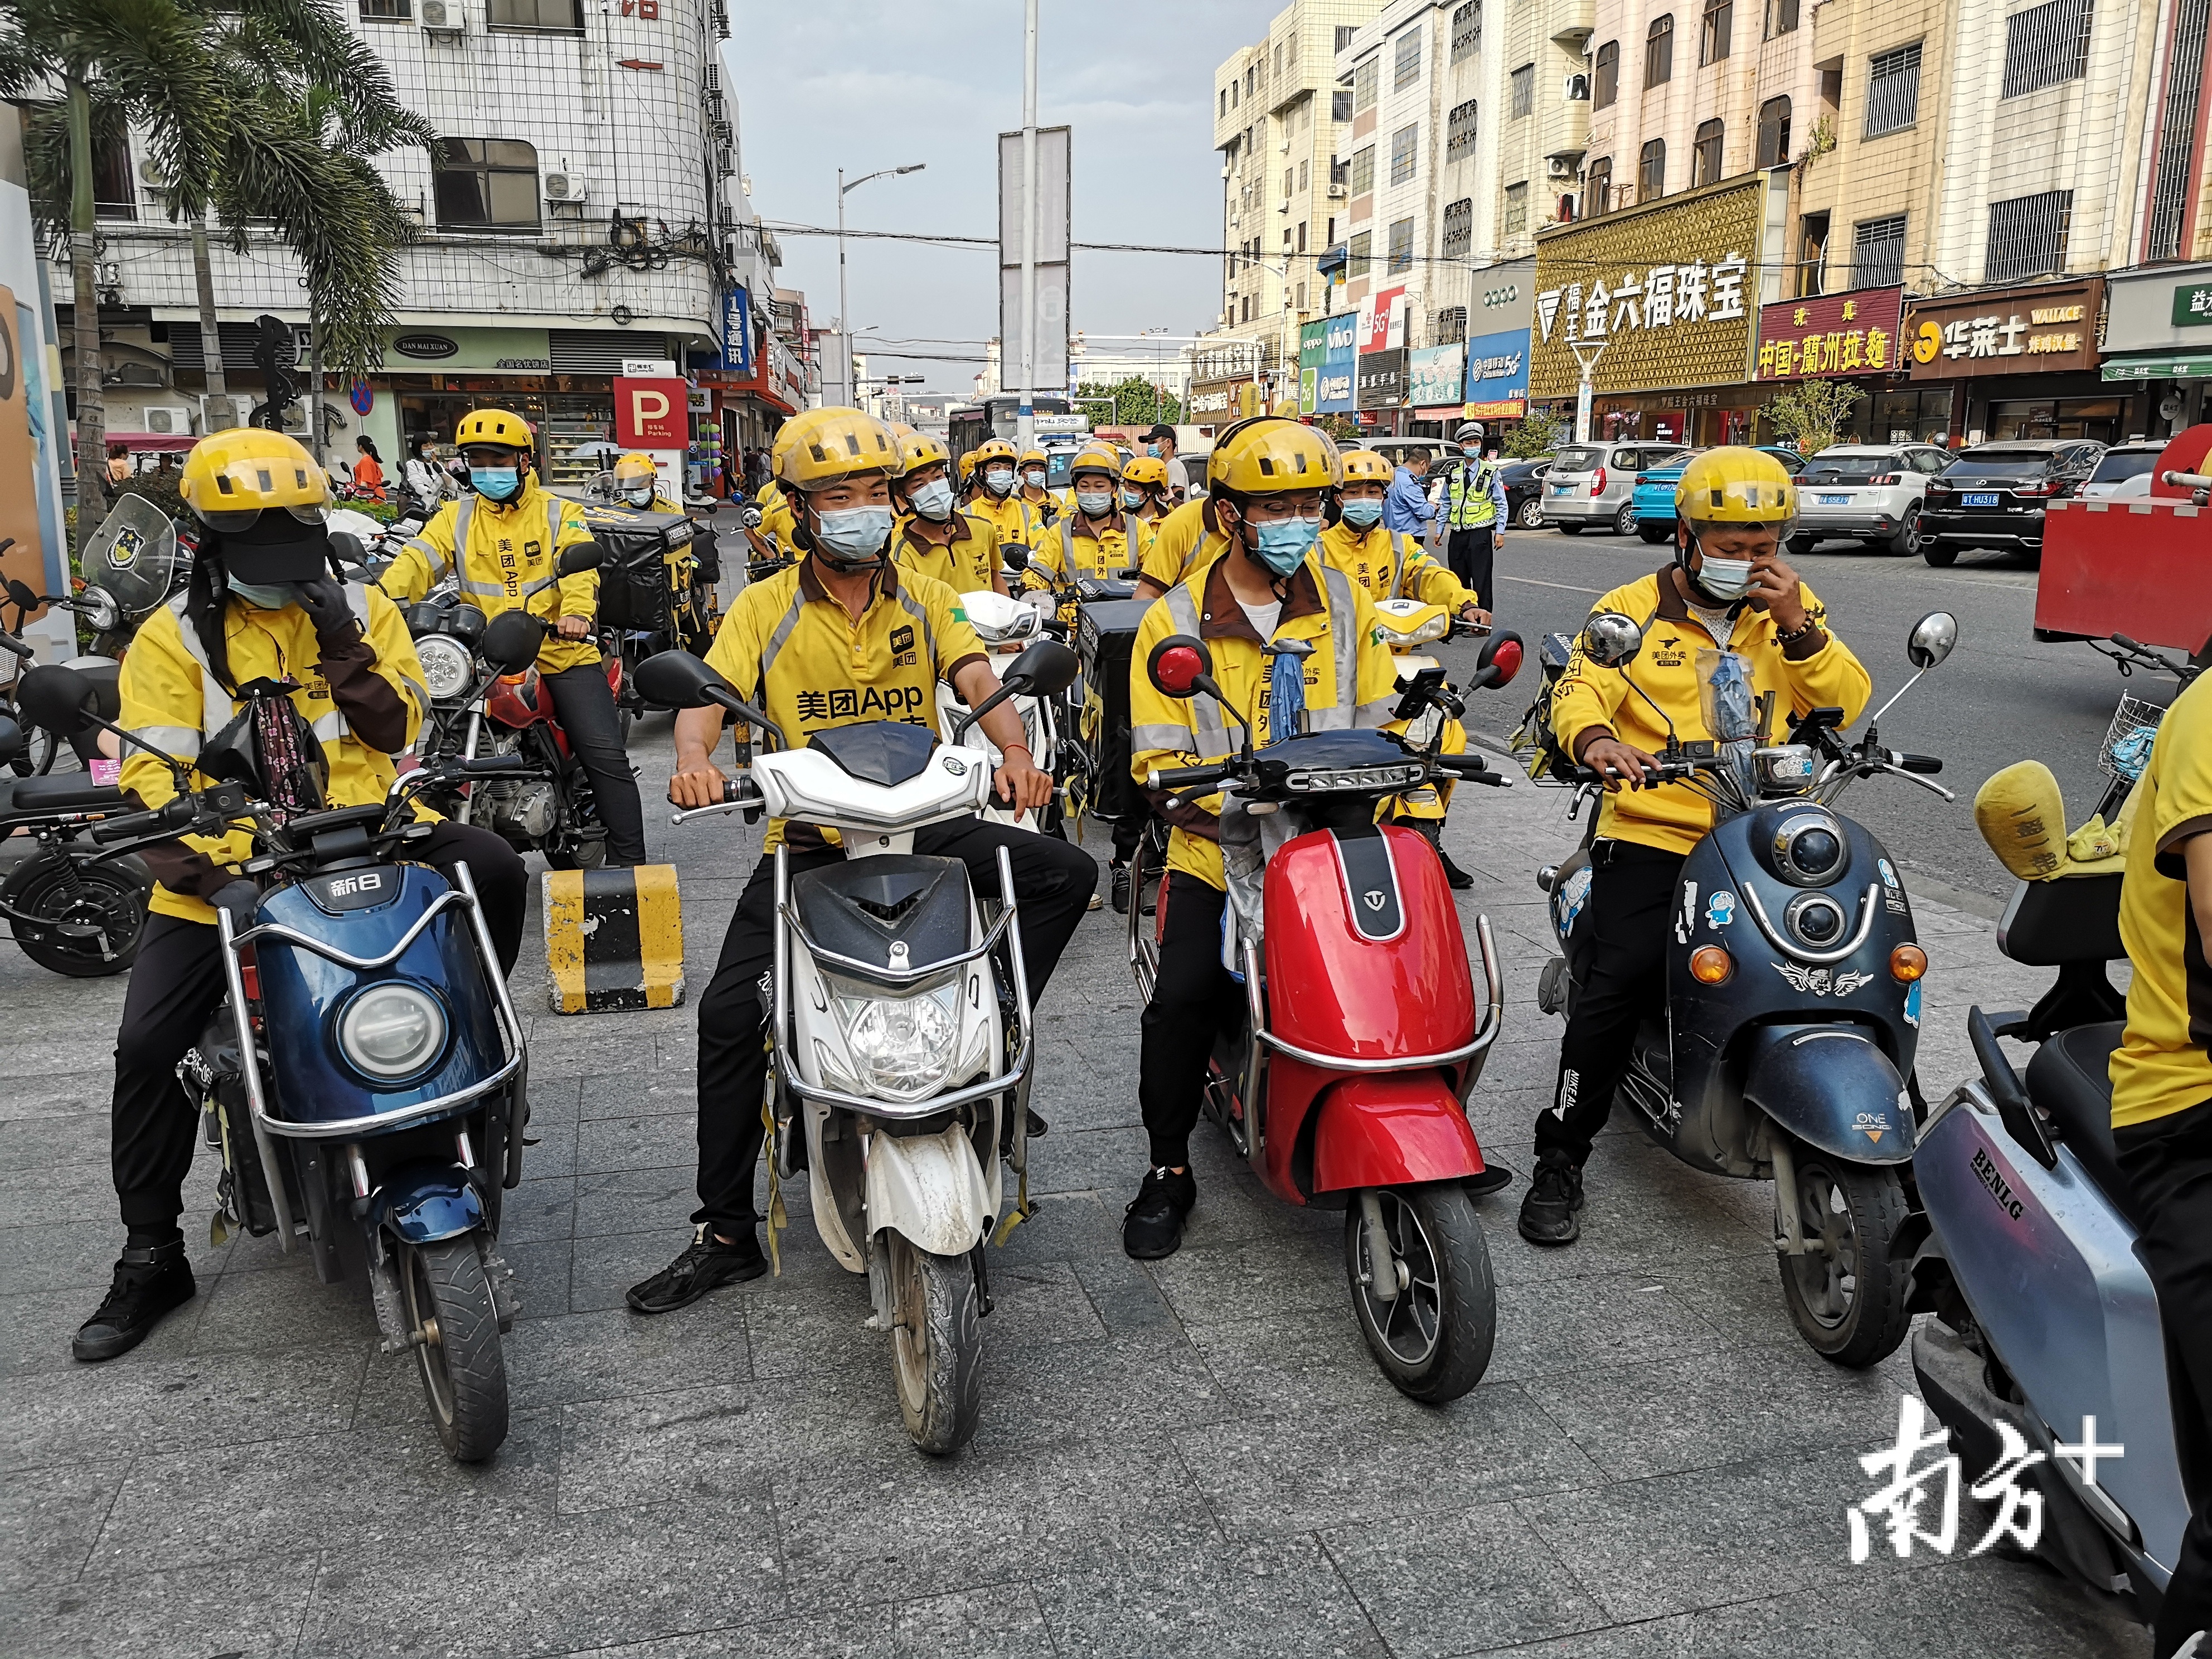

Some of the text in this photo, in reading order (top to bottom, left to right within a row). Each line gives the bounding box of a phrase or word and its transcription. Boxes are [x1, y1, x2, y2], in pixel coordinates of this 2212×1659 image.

[1584, 251, 1746, 337] 金六福珠宝
[2031, 305, 2082, 324] WALLACE
[726, 296, 743, 364] 1号通讯
[1943, 316, 2025, 359] 华莱士
[402, 342, 416, 350] DAN
[430, 342, 448, 351] XUAN
[2027, 333, 2078, 355] 炸鸡汉堡
[497, 359, 549, 370] 全国名优饼店
[632, 390, 670, 435] P
[892, 632, 912, 647] 美团
[892, 652, 916, 669] 美团
[1651, 651, 1687, 660] 美团外卖
[797, 686, 923, 722] 美团App
[331, 873, 381, 897] 新日
[1568, 1069, 1579, 1096] NIKE
[1857, 1113, 1886, 1124] ONE
